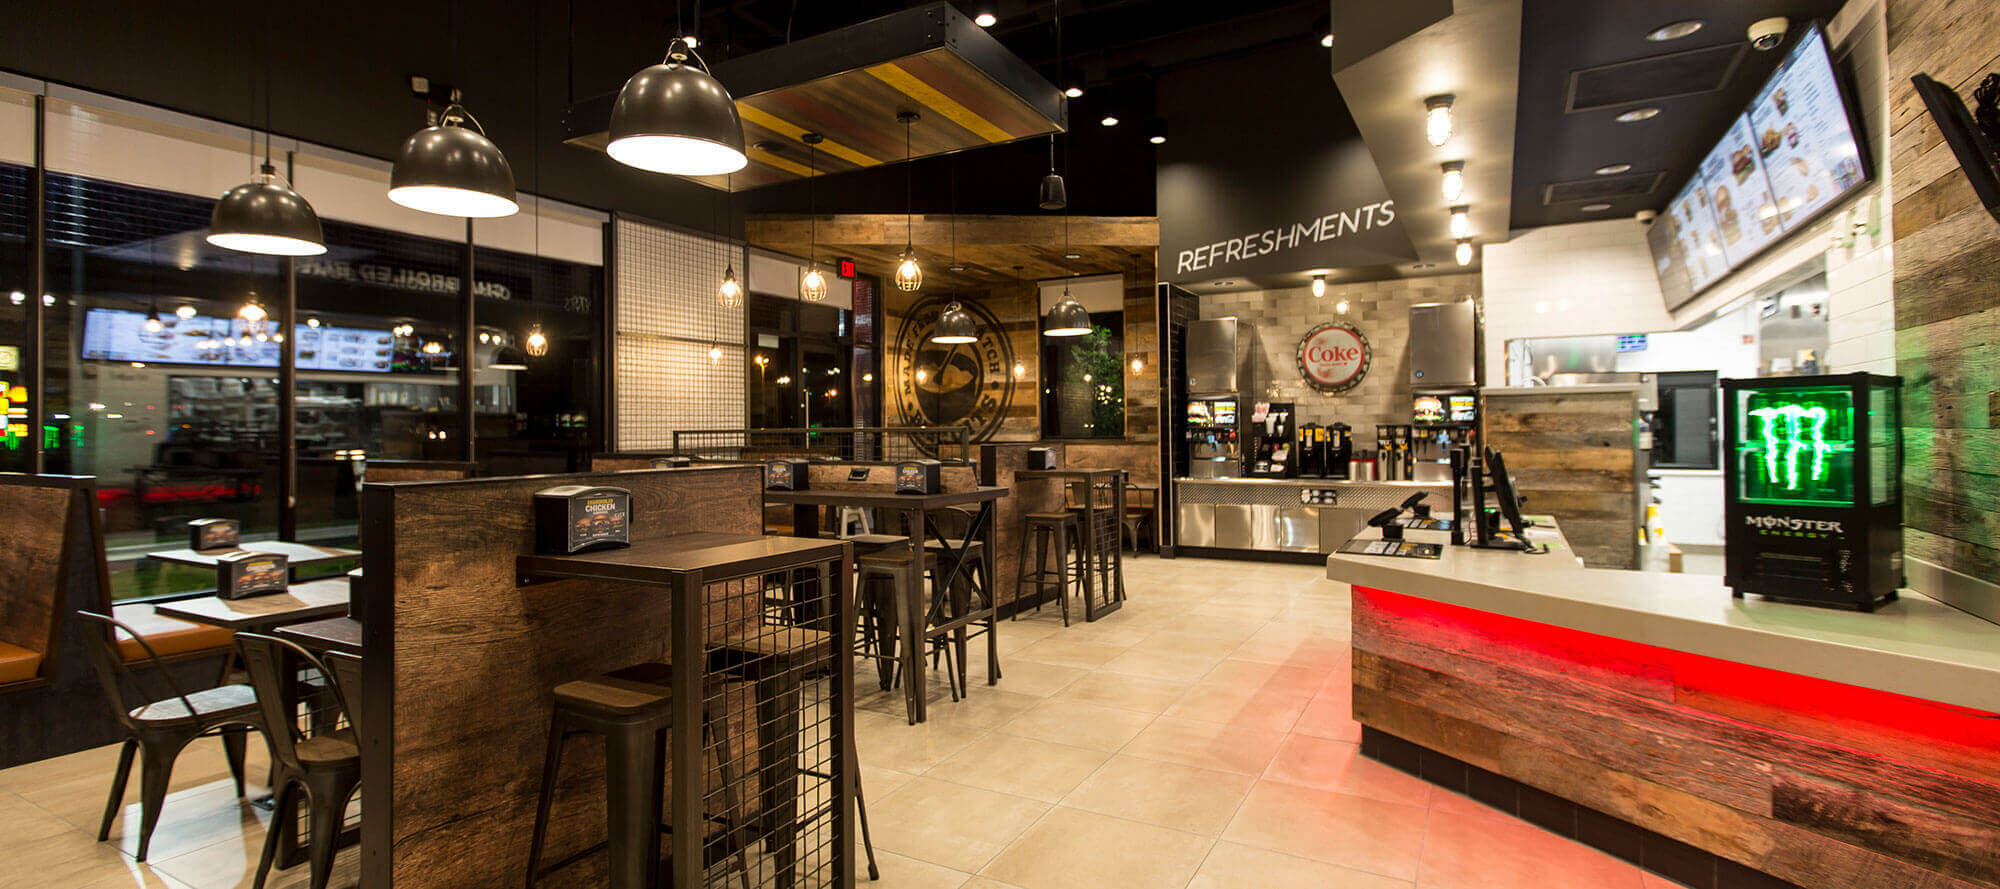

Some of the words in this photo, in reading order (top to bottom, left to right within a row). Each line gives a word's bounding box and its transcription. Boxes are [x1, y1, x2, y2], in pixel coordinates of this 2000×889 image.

[1177, 200, 1396, 275] REFRESHMENTS
[1308, 345, 1360, 363] Coke
[585, 502, 616, 513] CHICKEN
[1744, 514, 1844, 534] MONSTER
[1759, 529, 1829, 539] ENERGY
